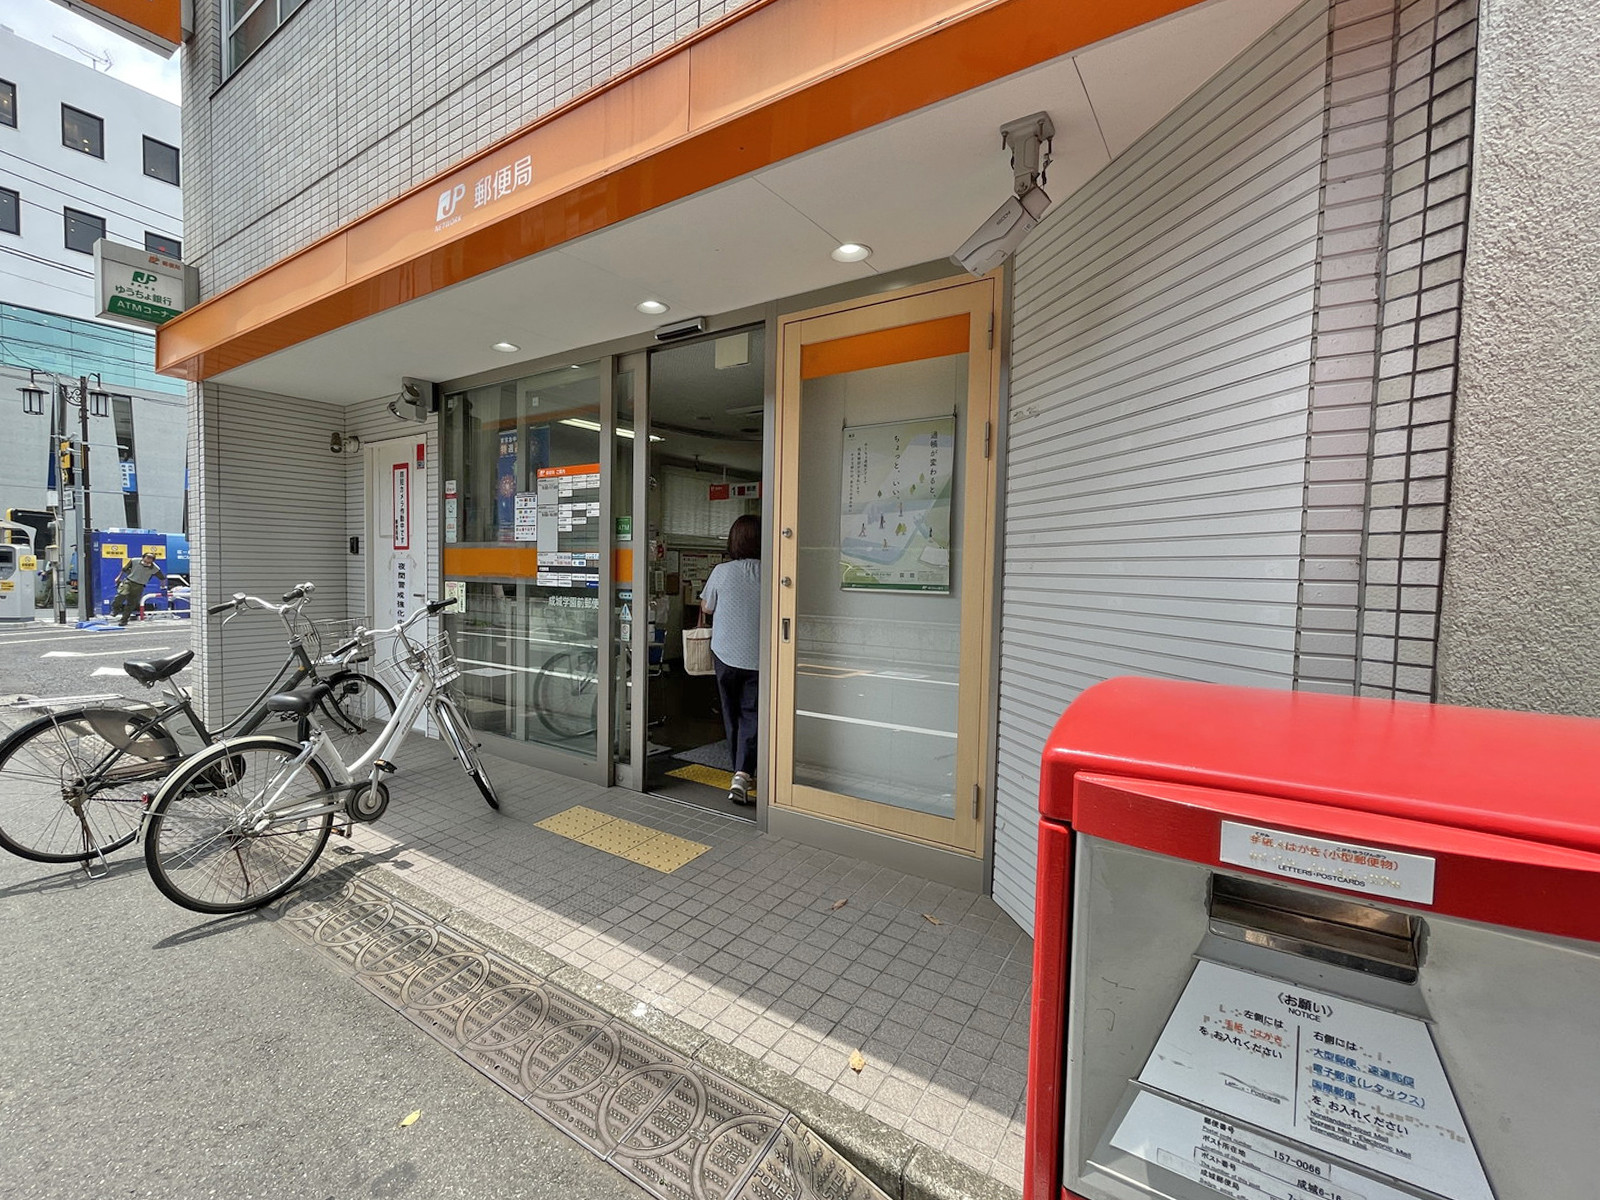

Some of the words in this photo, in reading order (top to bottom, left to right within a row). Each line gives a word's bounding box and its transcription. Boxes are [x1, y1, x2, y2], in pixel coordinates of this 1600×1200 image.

[474, 155, 532, 208] 郵便局
[115, 285, 172, 307] ゆうちょ銀行
[930, 430, 938, 498] 通帳が変わると、
[1244, 1010, 1284, 1029] 左側には
[1288, 1007, 1321, 1022] NOTICE
[1313, 1031, 1358, 1051] 右側には
[620, 1087, 649, 1105] STEP
[1312, 1078, 1356, 1103] 国際郵便
[654, 1107, 689, 1129] POWER
[1204, 1117, 1235, 1135] 郵便番号
[714, 1143, 746, 1165] STEP
[1202, 1135, 1246, 1157] ポスト所在地
[1202, 1152, 1236, 1172] ポスト番号
[1273, 1150, 1321, 1175] 157-0066
